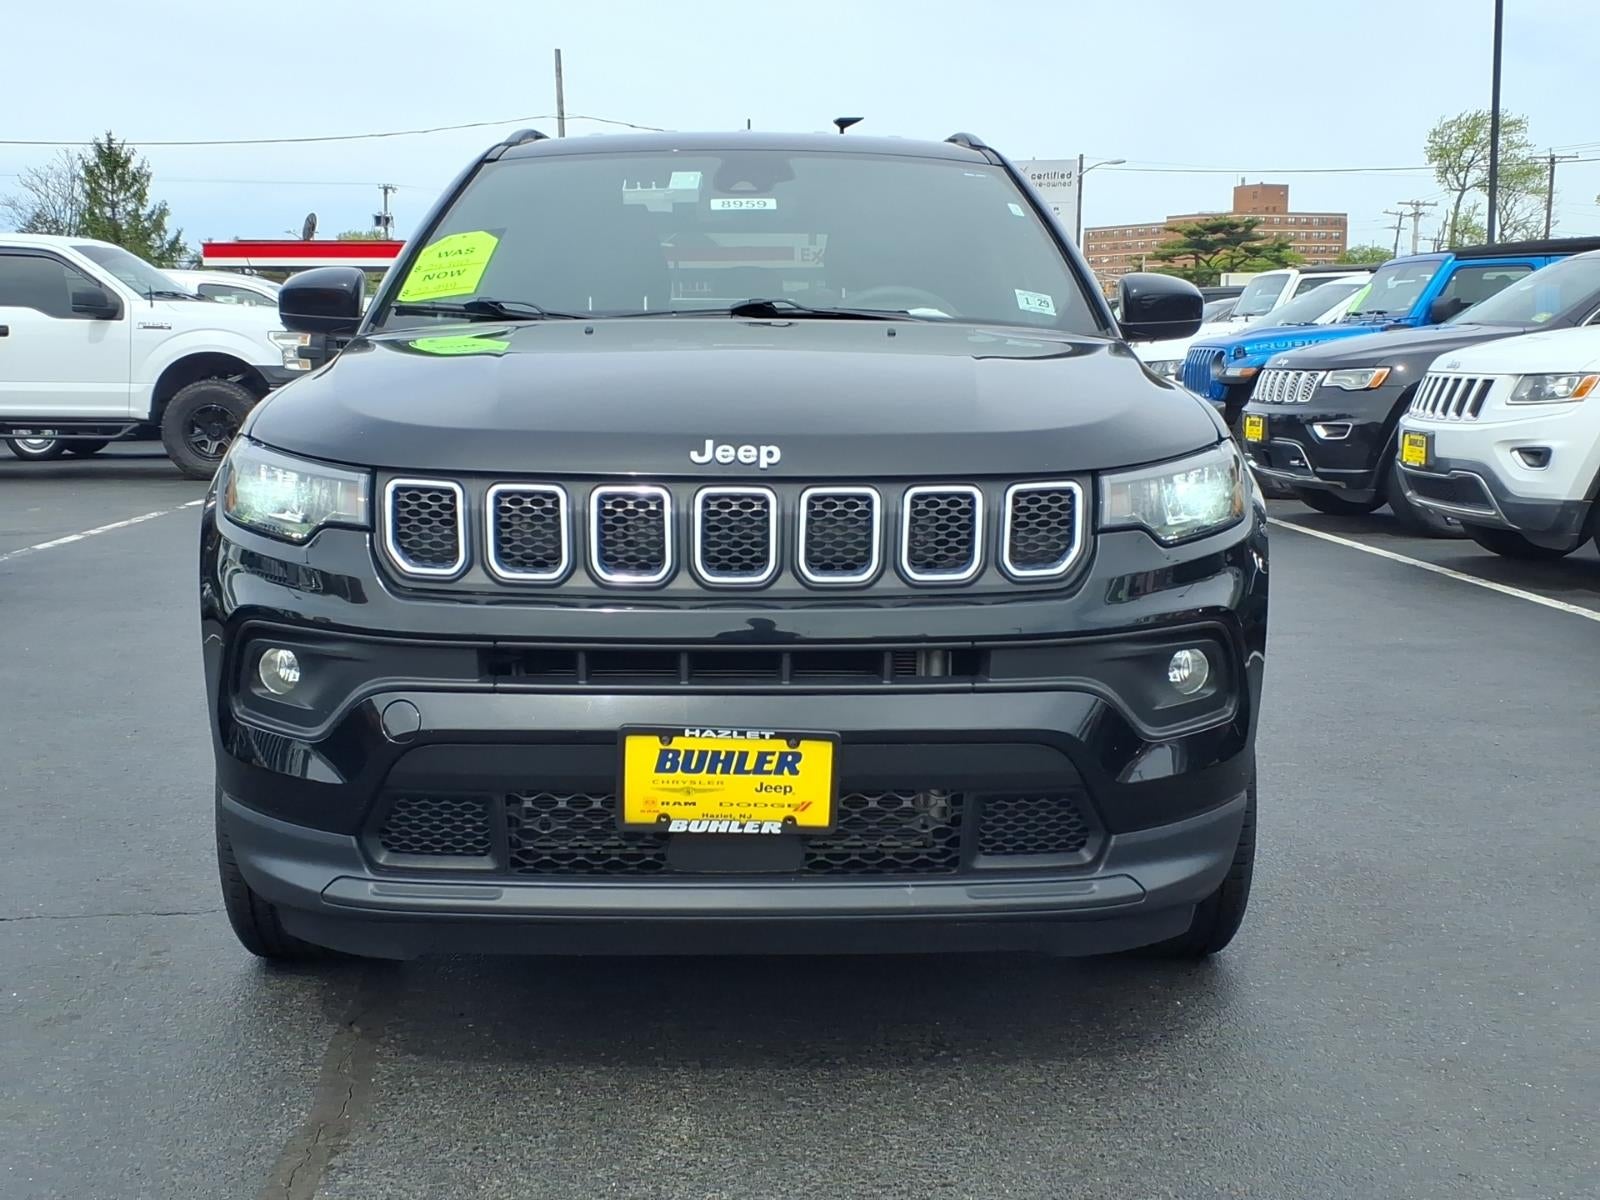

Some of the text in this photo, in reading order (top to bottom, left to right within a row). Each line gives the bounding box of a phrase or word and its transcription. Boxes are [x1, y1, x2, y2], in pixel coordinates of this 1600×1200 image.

[1031, 171, 1072, 180] certified
[721, 200, 767, 209] 8959
[438, 247, 475, 258] WAS
[422, 268, 467, 282] NOW
[1254, 338, 1322, 350] RUBI
[689, 439, 781, 469] Jeep
[684, 728, 775, 740] HAZLET
[654, 748, 803, 776] BUHLER
[754, 782, 793, 795] Jeep
[668, 819, 782, 834] BUHLER
